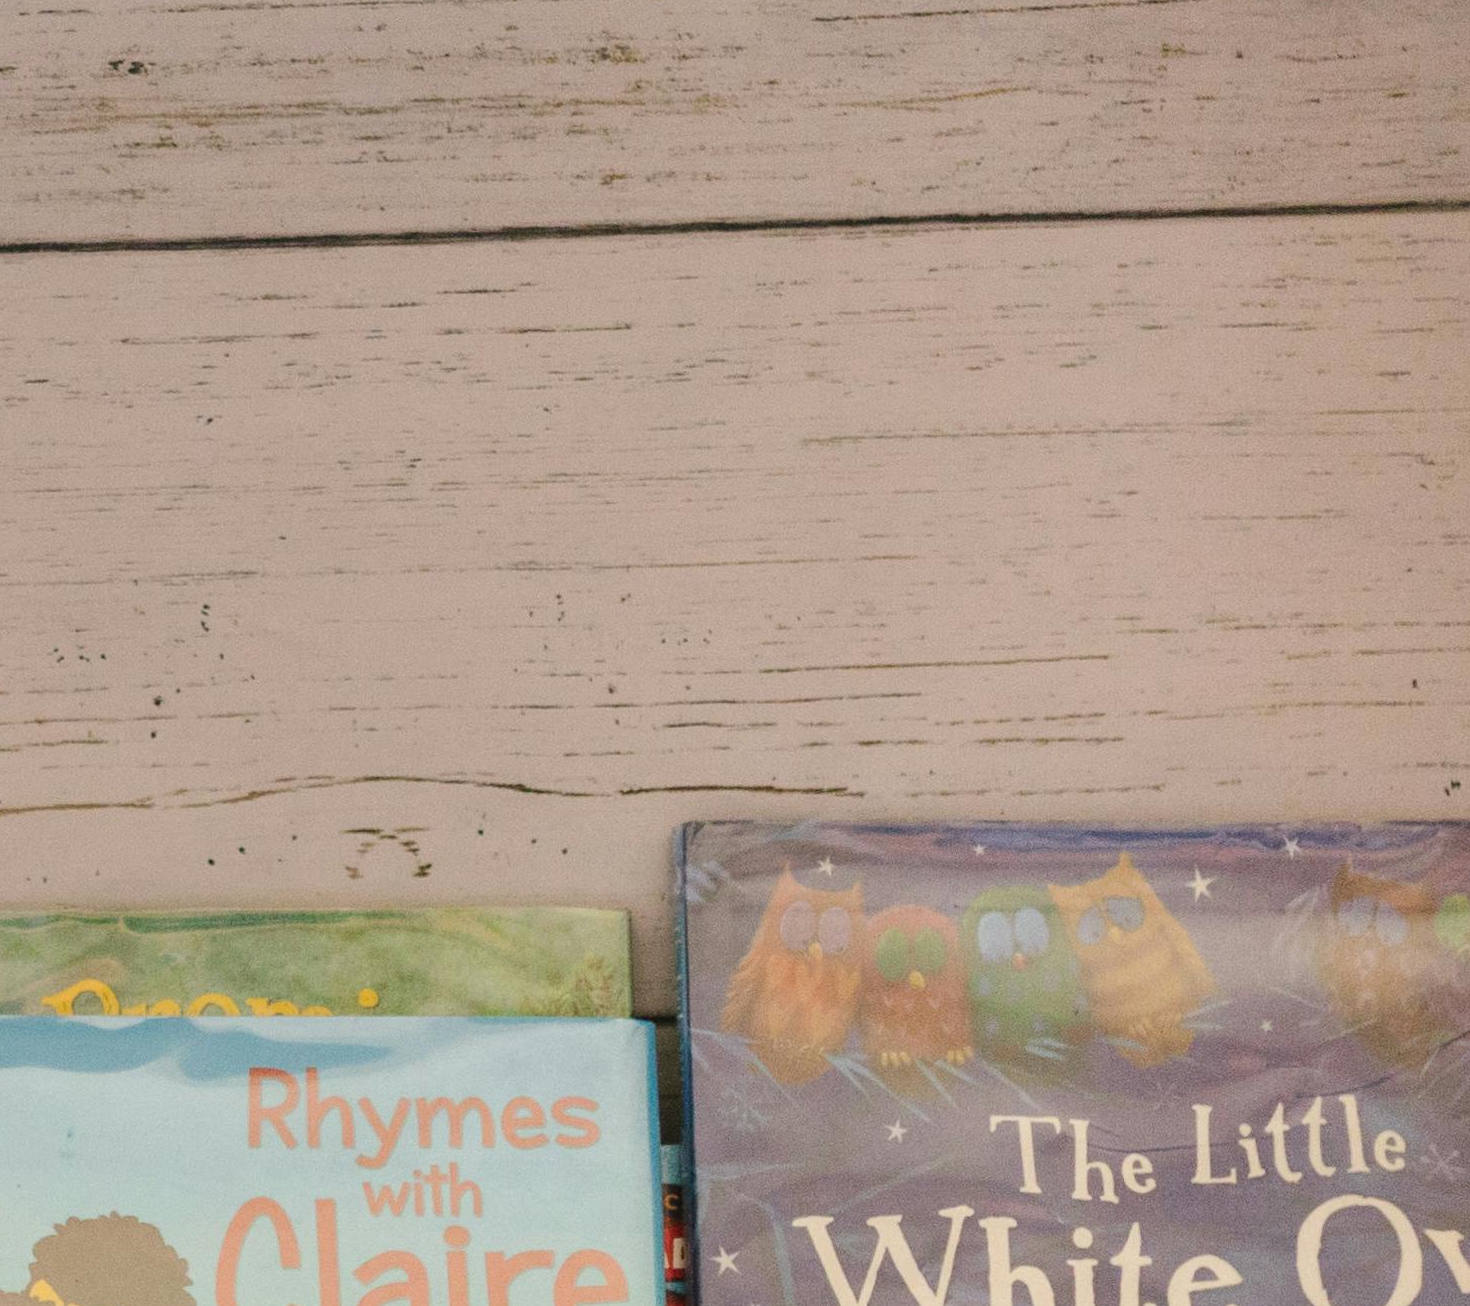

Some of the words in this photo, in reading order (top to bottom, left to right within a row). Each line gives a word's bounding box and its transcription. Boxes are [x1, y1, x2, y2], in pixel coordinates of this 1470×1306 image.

[244, 1066, 605, 1170] Rhymes
[989, 1113, 1158, 1205] The
[1191, 1094, 1409, 1187] Little
[362, 1160, 485, 1220] with
